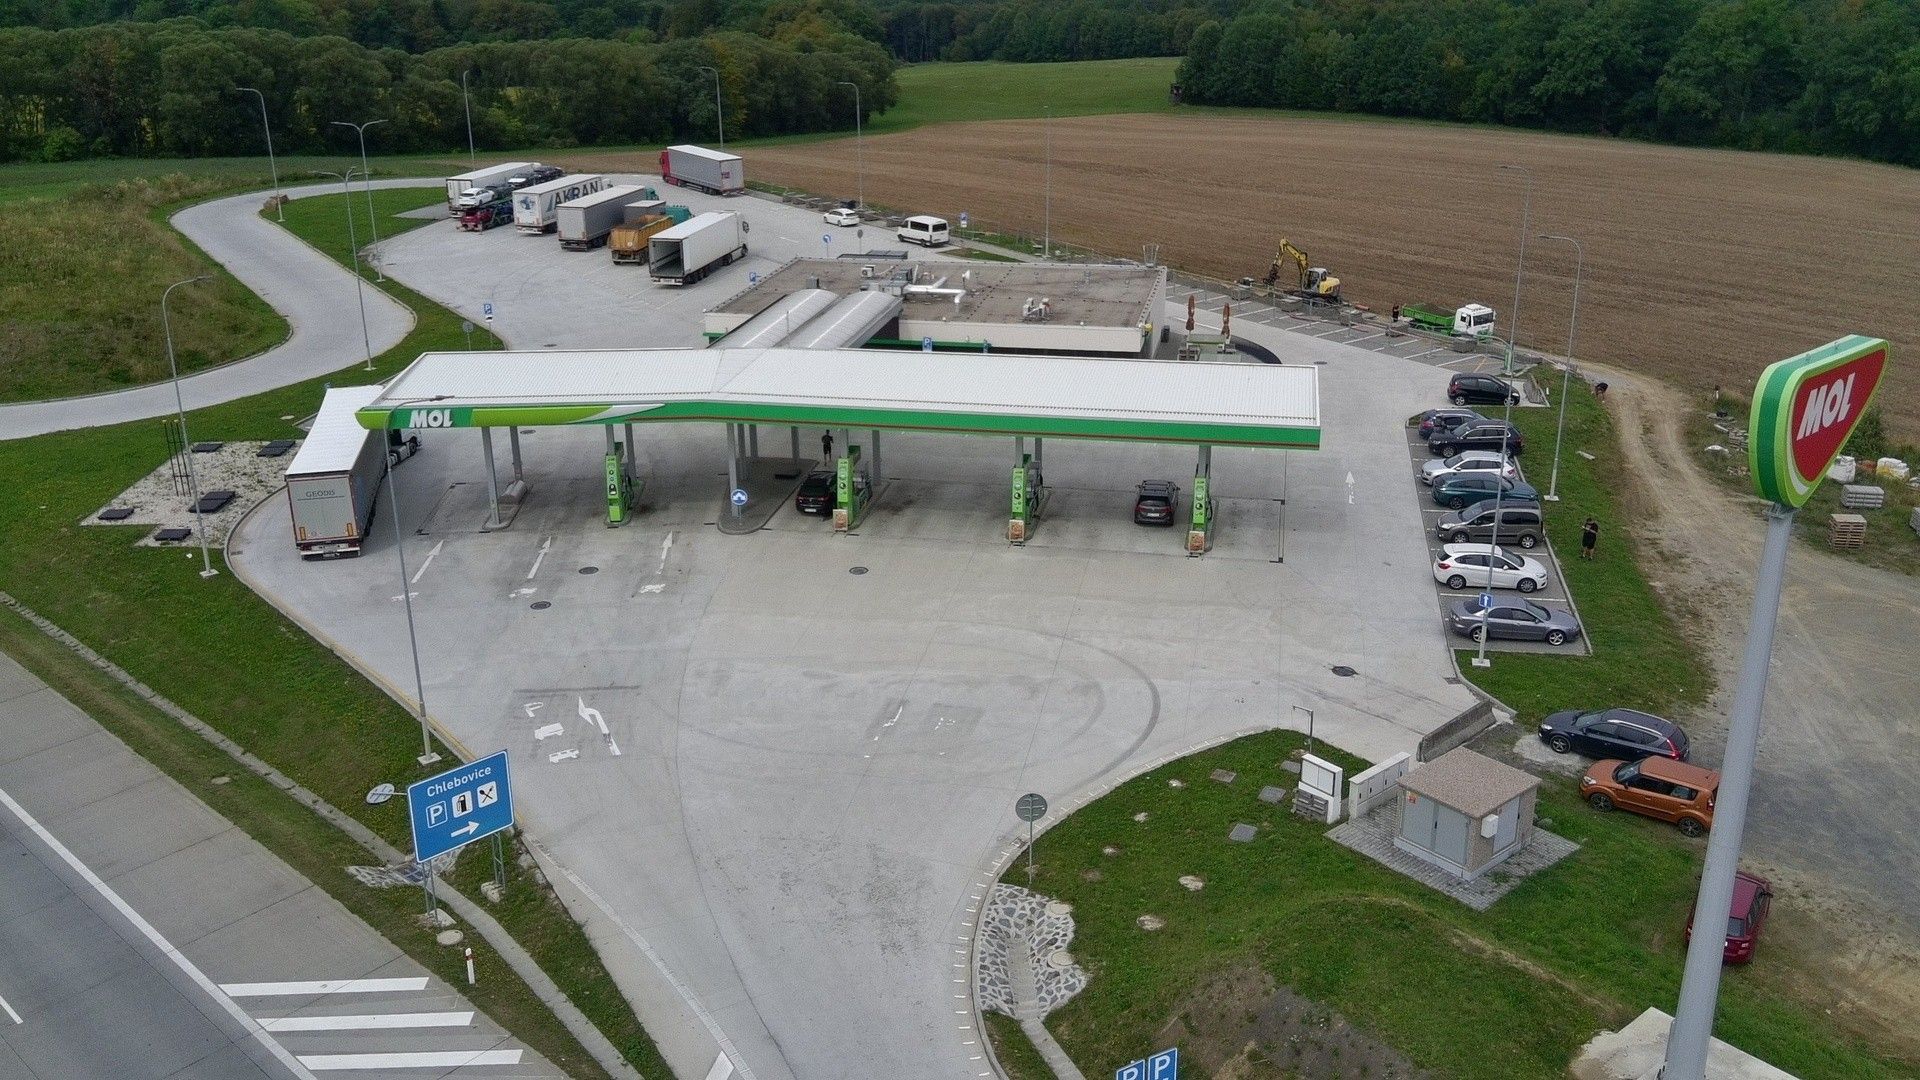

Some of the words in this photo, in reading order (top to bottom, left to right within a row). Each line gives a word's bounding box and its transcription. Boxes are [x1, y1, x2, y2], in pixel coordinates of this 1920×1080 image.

[1796, 372, 1856, 441] MOL
[408, 409, 453, 428] MOL
[305, 490, 336, 498] GEODIS
[426, 766, 492, 797] Chlebovice
[429, 805, 443, 825] P
[1155, 1055, 1171, 1080] P
